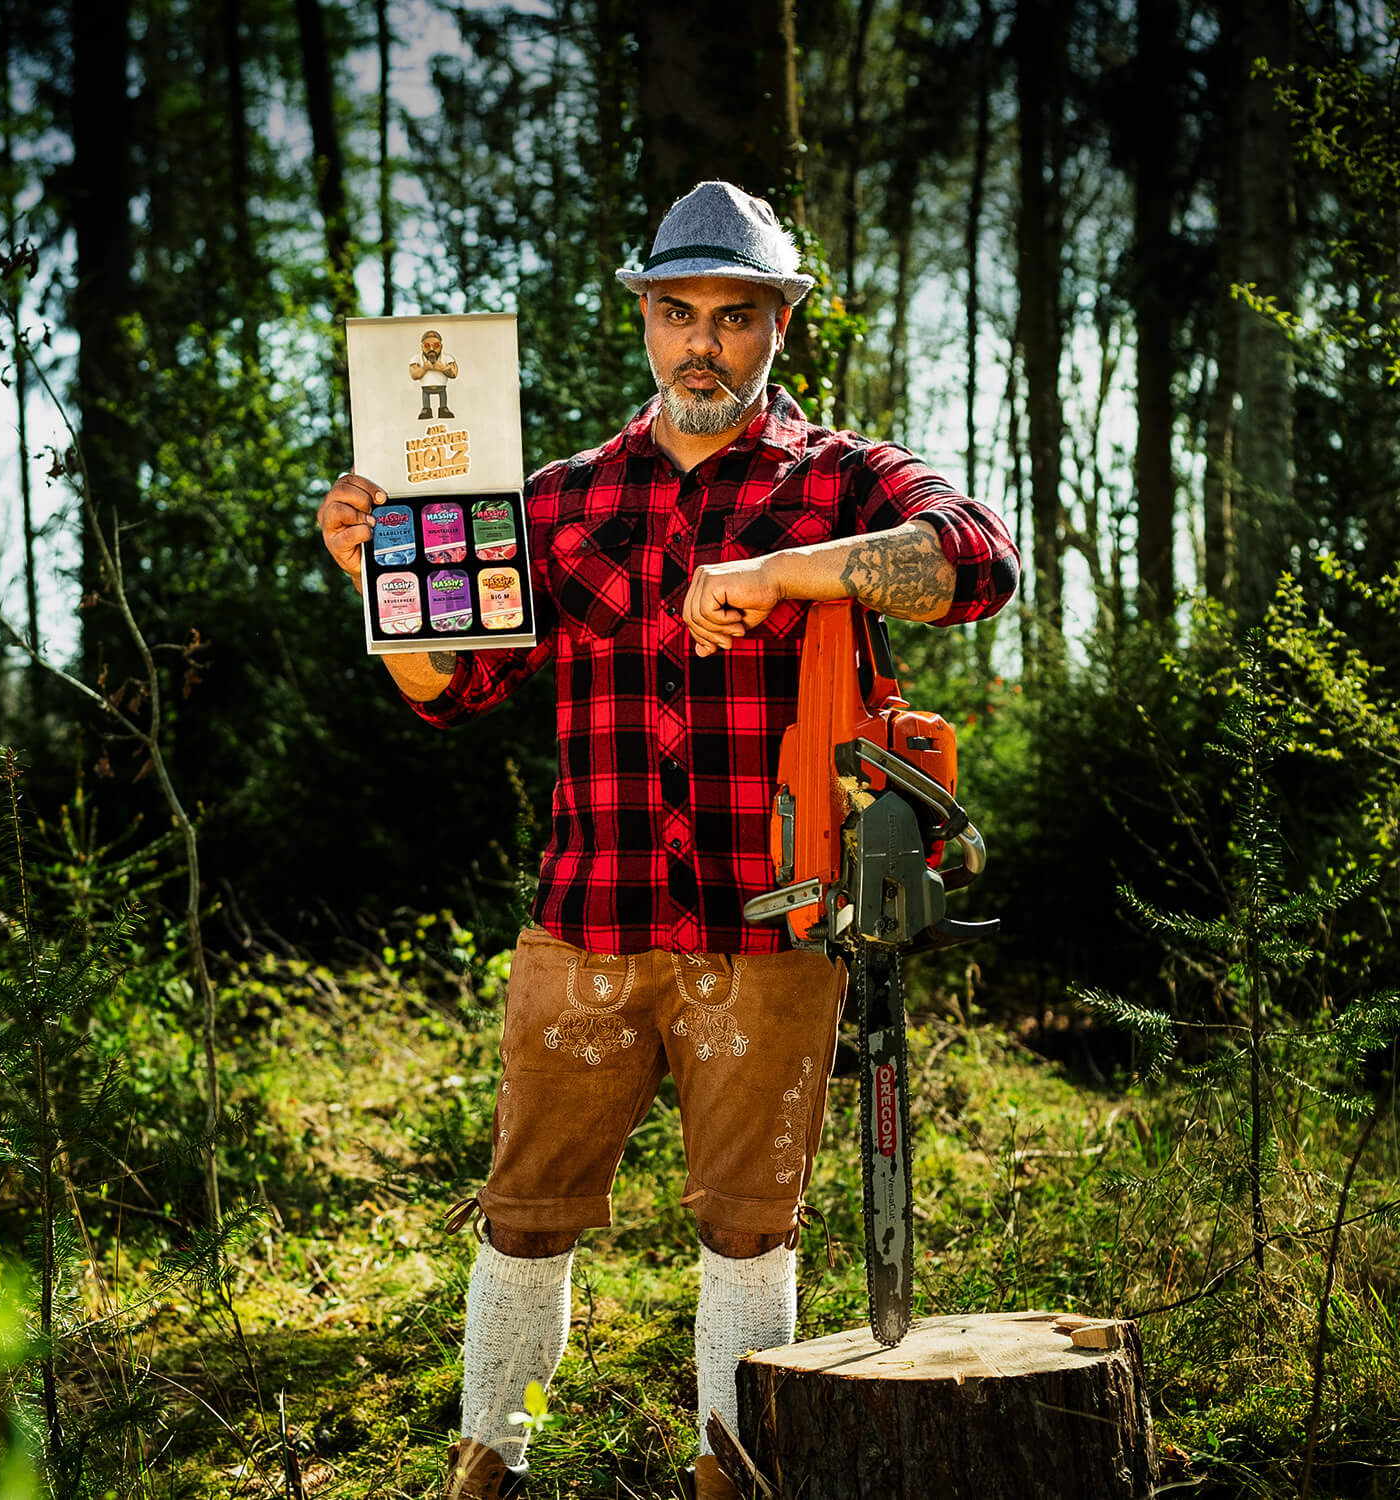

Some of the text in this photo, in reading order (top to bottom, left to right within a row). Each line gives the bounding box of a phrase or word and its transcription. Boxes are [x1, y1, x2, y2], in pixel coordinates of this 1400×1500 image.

[406, 431, 468, 451] MASSIVEN
[406, 443, 469, 473] HOLZ
[880, 1068, 893, 1149] OREGON
